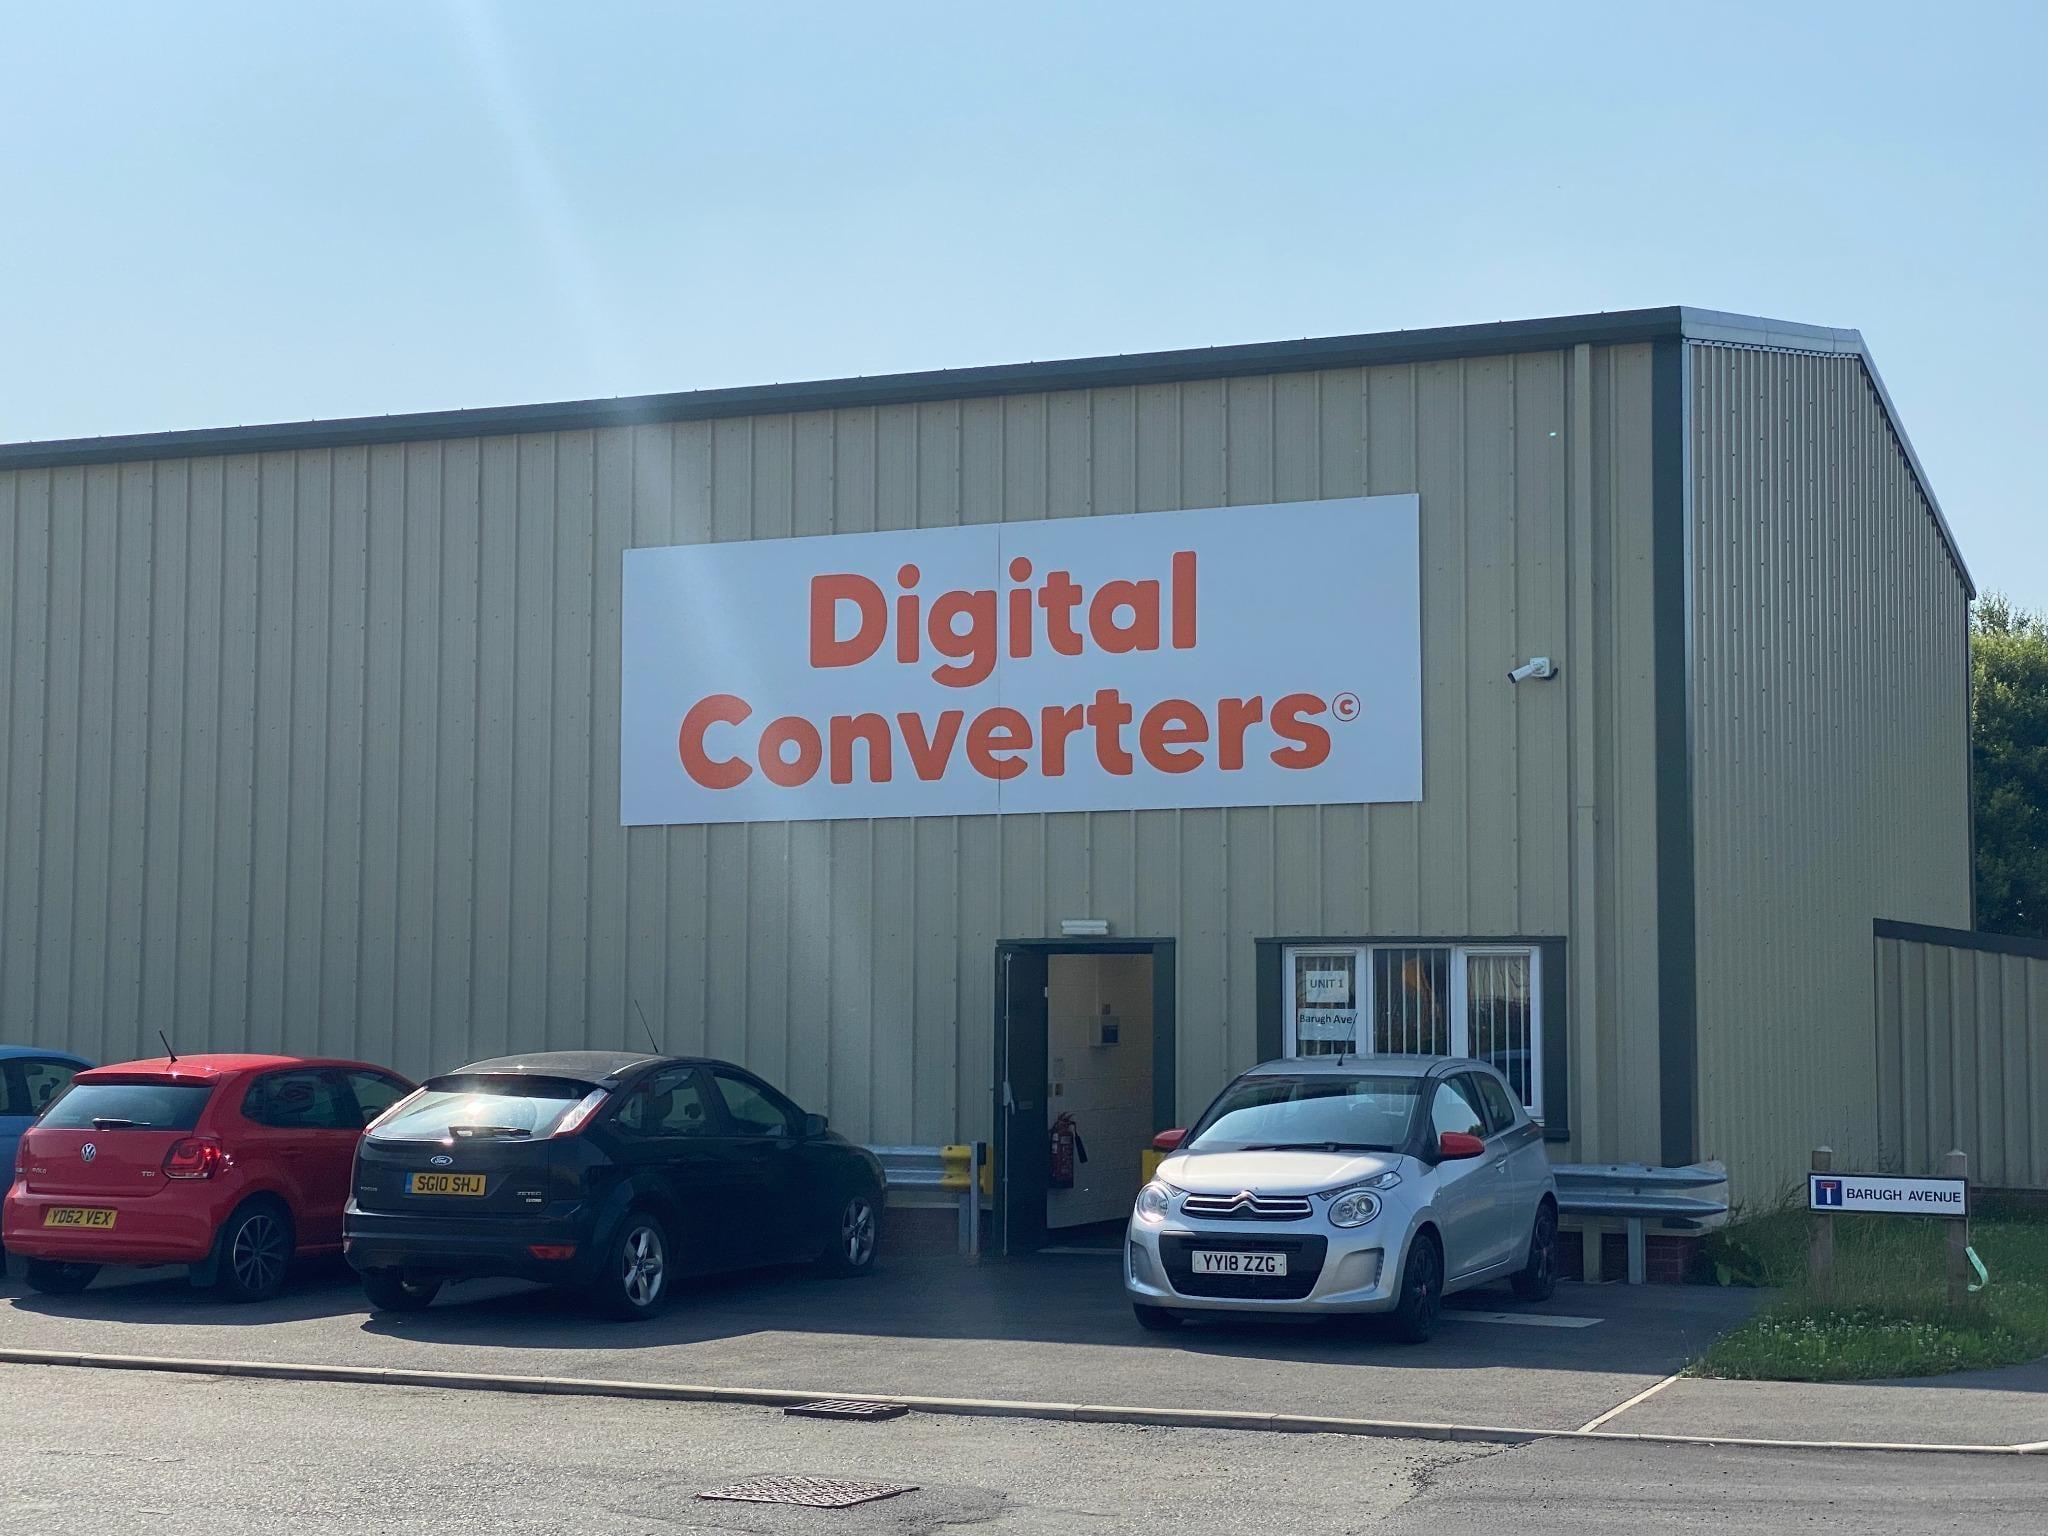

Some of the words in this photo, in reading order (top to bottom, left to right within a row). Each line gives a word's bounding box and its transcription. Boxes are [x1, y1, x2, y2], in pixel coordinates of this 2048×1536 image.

[808, 550, 1197, 688] Digital
[1310, 979, 1335, 988] UNIT
[1300, 1014, 1332, 1025] Barugh
[417, 1175, 448, 1191] SG10
[452, 1177, 481, 1192] SHJ
[1846, 1188, 1902, 1200] BARUGH
[1908, 1190, 1961, 1203] AVENUE
[85, 1211, 113, 1225] VEX
[1203, 1254, 1238, 1271] YY18
[1243, 1255, 1276, 1272] ZZG
